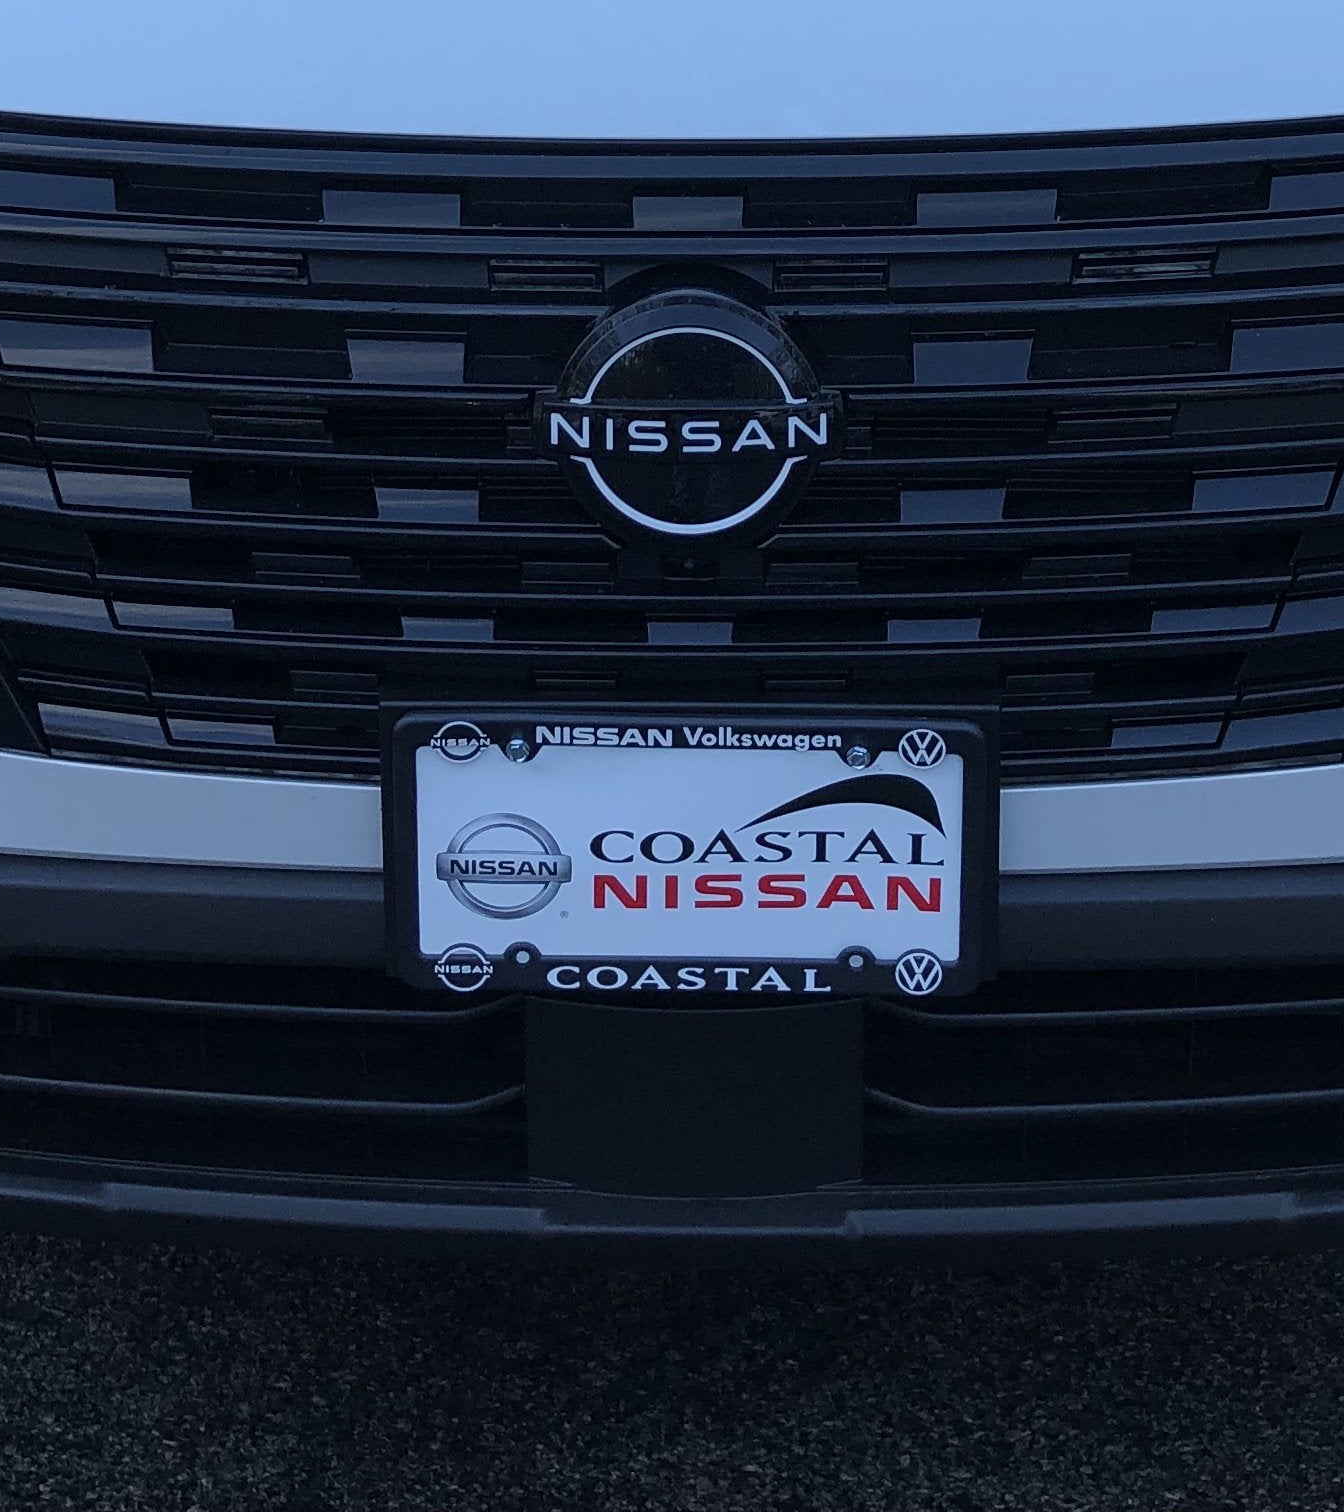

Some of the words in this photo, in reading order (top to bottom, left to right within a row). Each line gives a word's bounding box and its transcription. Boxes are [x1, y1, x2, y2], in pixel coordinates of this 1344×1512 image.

[549, 411, 828, 453] NISSAN
[430, 737, 491, 747] NISSAN
[535, 725, 673, 747] NISSAN
[682, 726, 842, 752] Volkswagen
[589, 828, 945, 866] COASTAL
[449, 859, 558, 876] NISSAN
[592, 874, 942, 913] NISSAN
[434, 964, 493, 974] NISSAN
[546, 964, 832, 992] COASTAL
